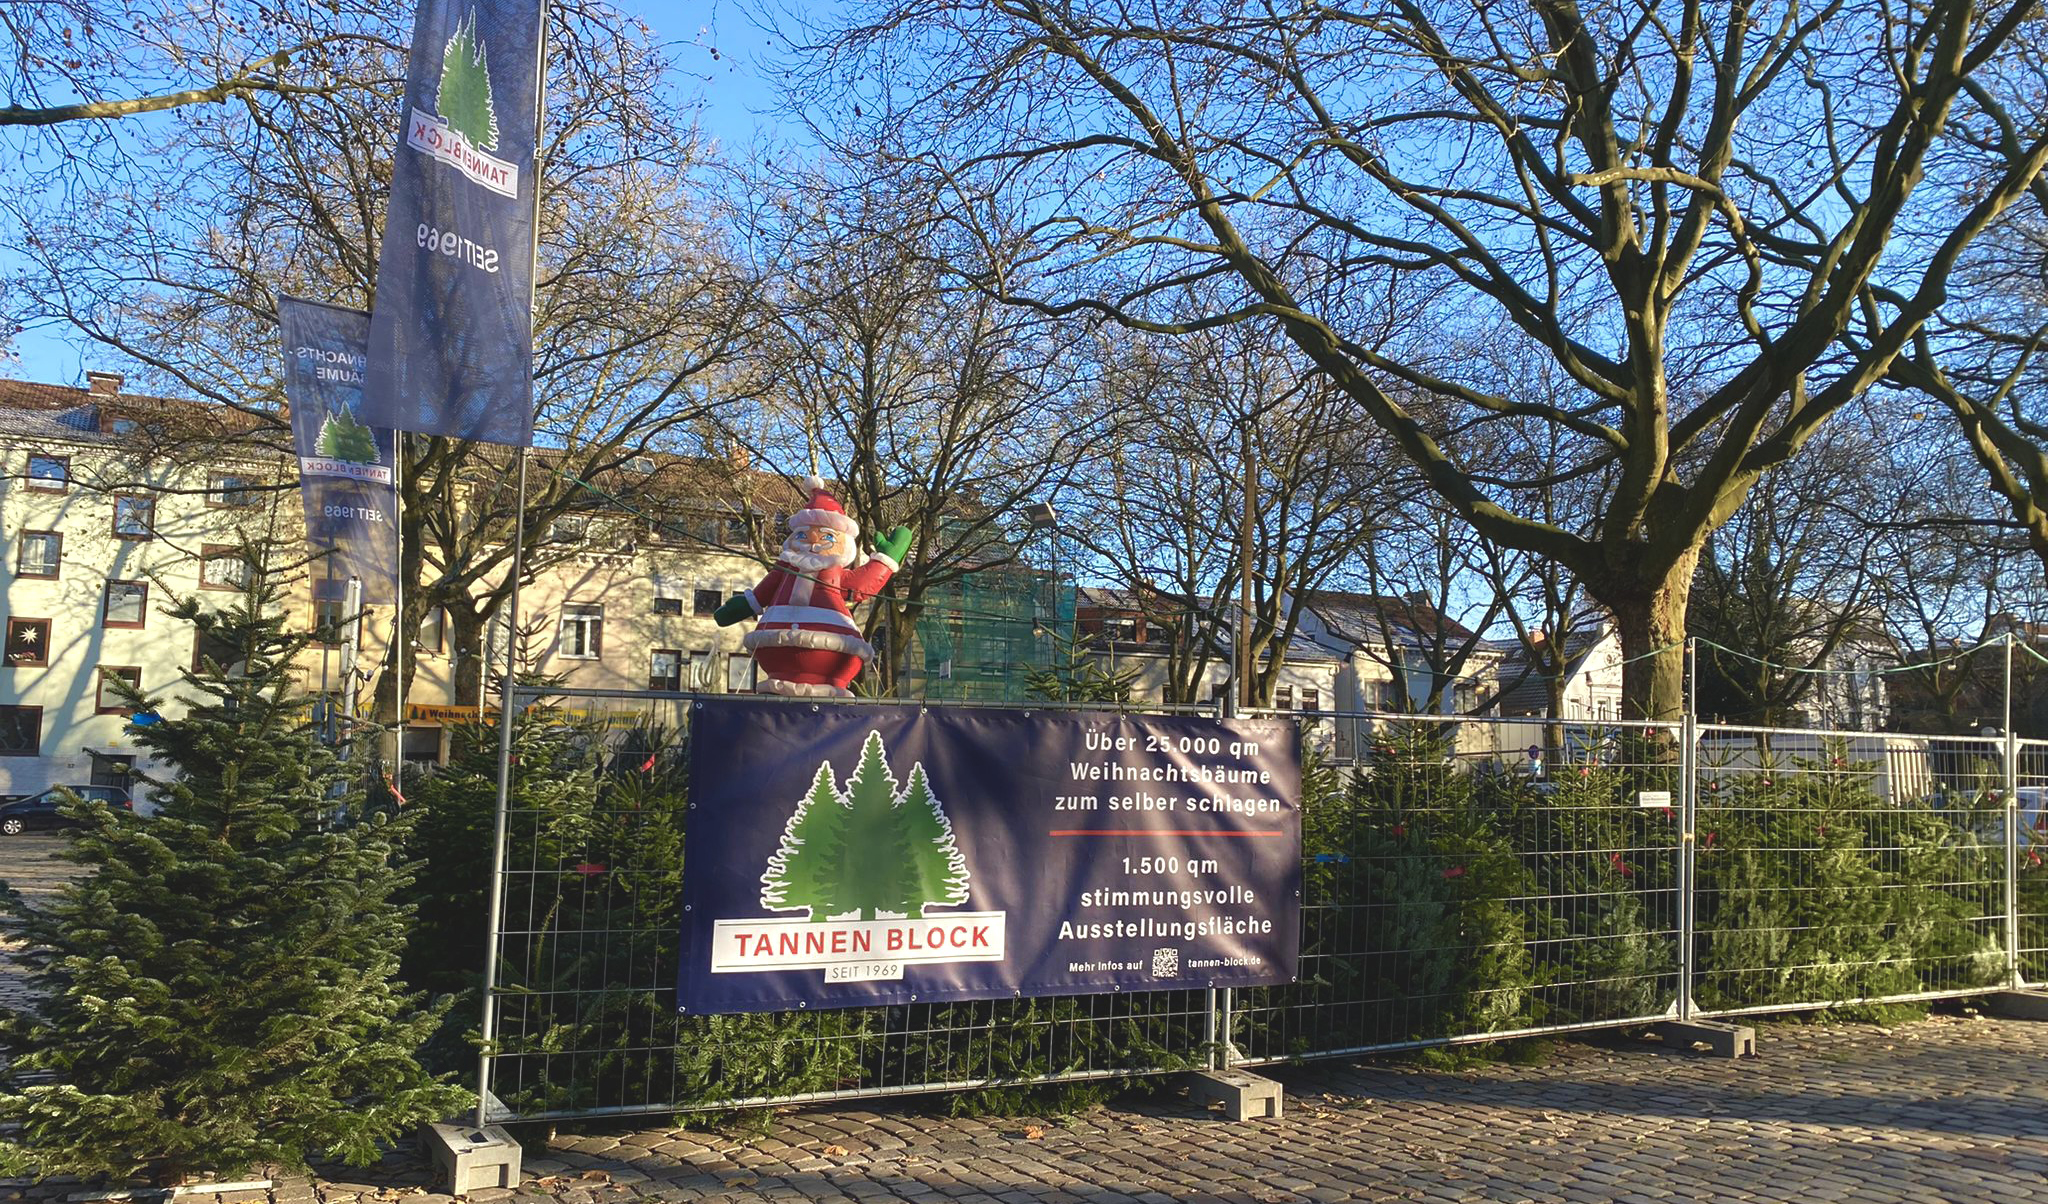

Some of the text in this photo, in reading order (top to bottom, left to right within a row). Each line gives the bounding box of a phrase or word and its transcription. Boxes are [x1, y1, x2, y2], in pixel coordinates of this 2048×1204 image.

[1085, 729, 1259, 759] Über 25.000 qm
[1070, 762, 1271, 784] Weihnachtsbäume
[1055, 792, 1280, 816] zum selber schlagen
[1122, 857, 1218, 878] 1.500 qm
[1080, 885, 1254, 909] stimmungsvolle
[1058, 915, 1272, 940] Ausstellungsfläche
[735, 925, 990, 957] TANNEN BLOCK
[832, 964, 898, 979] SEIT 1969
[1069, 960, 1143, 972] Mehr Infos auf
[1188, 957, 1261, 968] tannen-block.de
